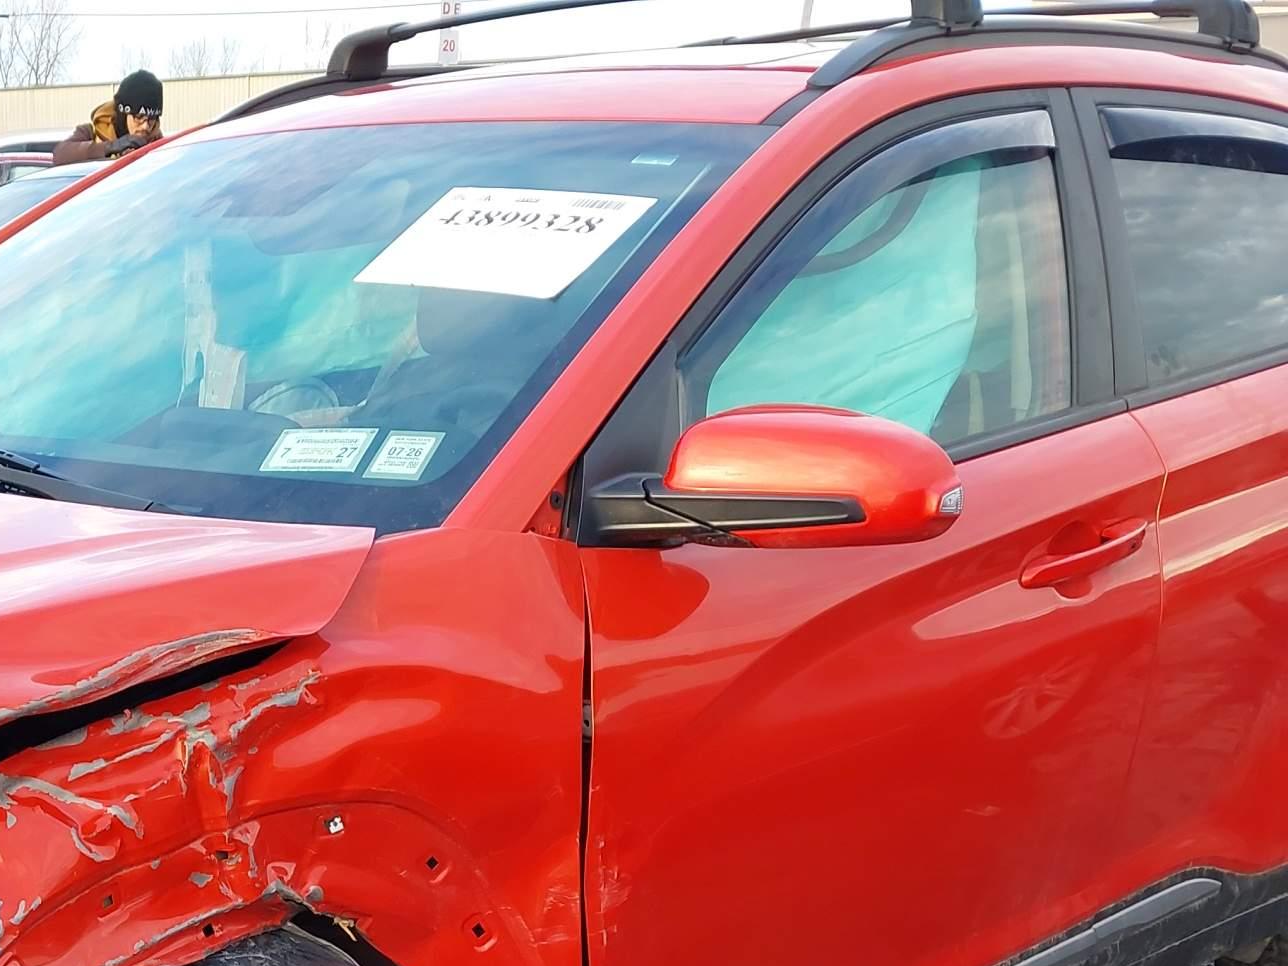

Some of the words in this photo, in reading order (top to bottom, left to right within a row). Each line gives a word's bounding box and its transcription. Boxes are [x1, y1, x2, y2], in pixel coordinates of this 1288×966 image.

[443, 39, 455, 52] 20
[439, 208, 605, 234] 43899328
[280, 447, 292, 458] 7
[335, 446, 358, 459] 27
